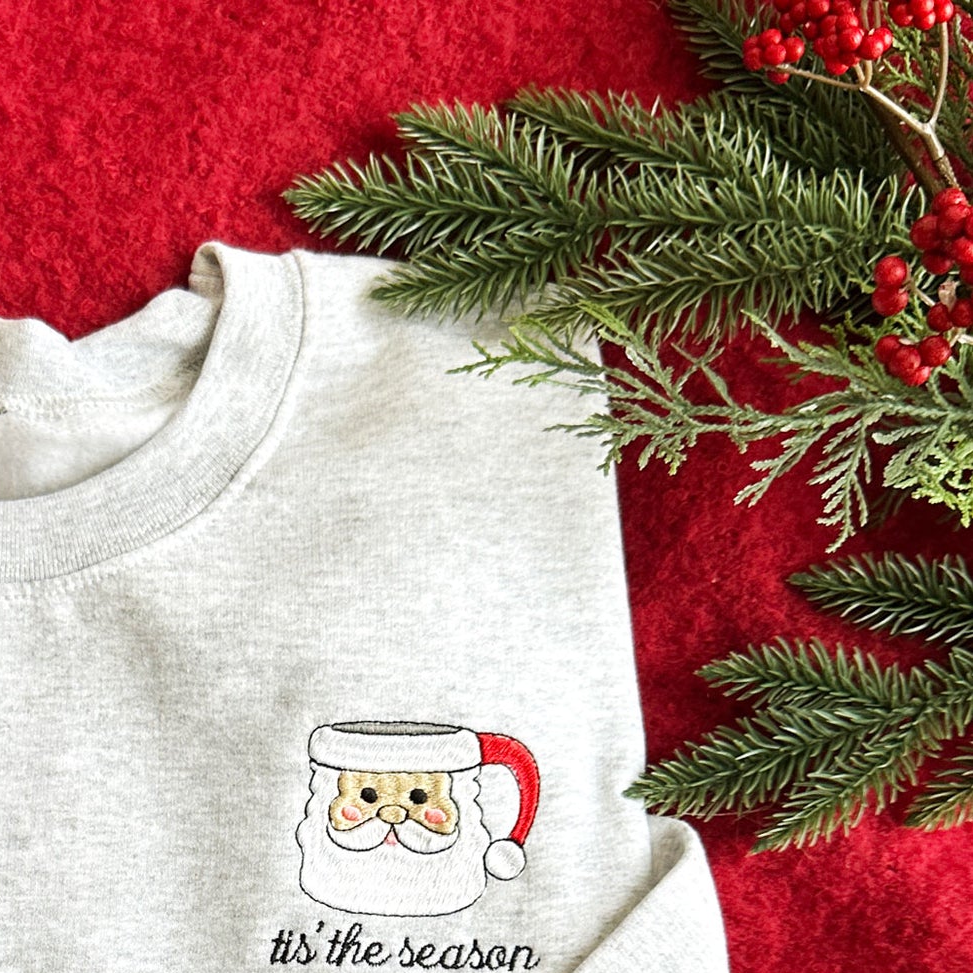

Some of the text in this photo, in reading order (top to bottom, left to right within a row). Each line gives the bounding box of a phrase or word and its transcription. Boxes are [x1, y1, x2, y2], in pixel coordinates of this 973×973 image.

[270, 921, 541, 971] tis' the season
